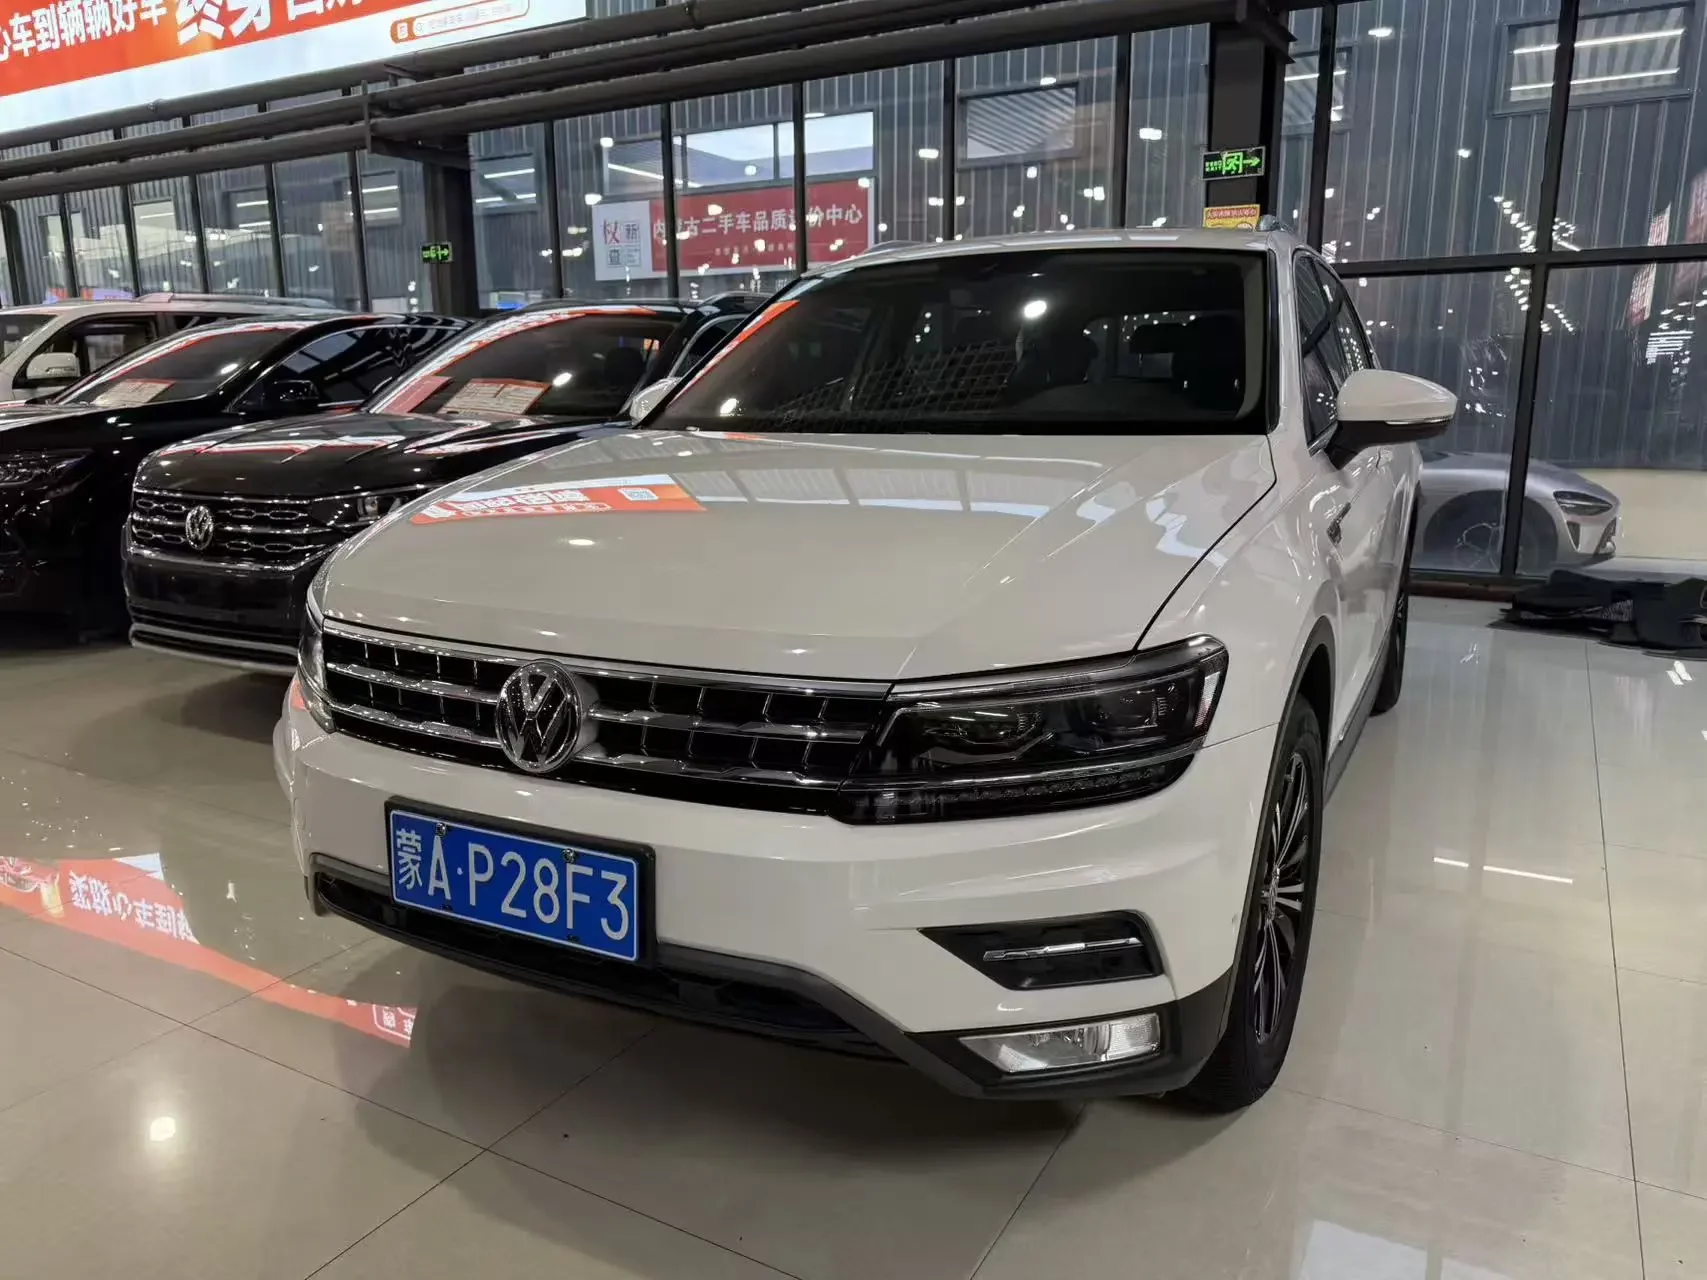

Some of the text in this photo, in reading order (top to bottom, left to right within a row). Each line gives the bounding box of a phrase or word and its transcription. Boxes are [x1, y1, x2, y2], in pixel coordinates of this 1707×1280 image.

[653, 204, 863, 239] 内古二手车品质价中心
